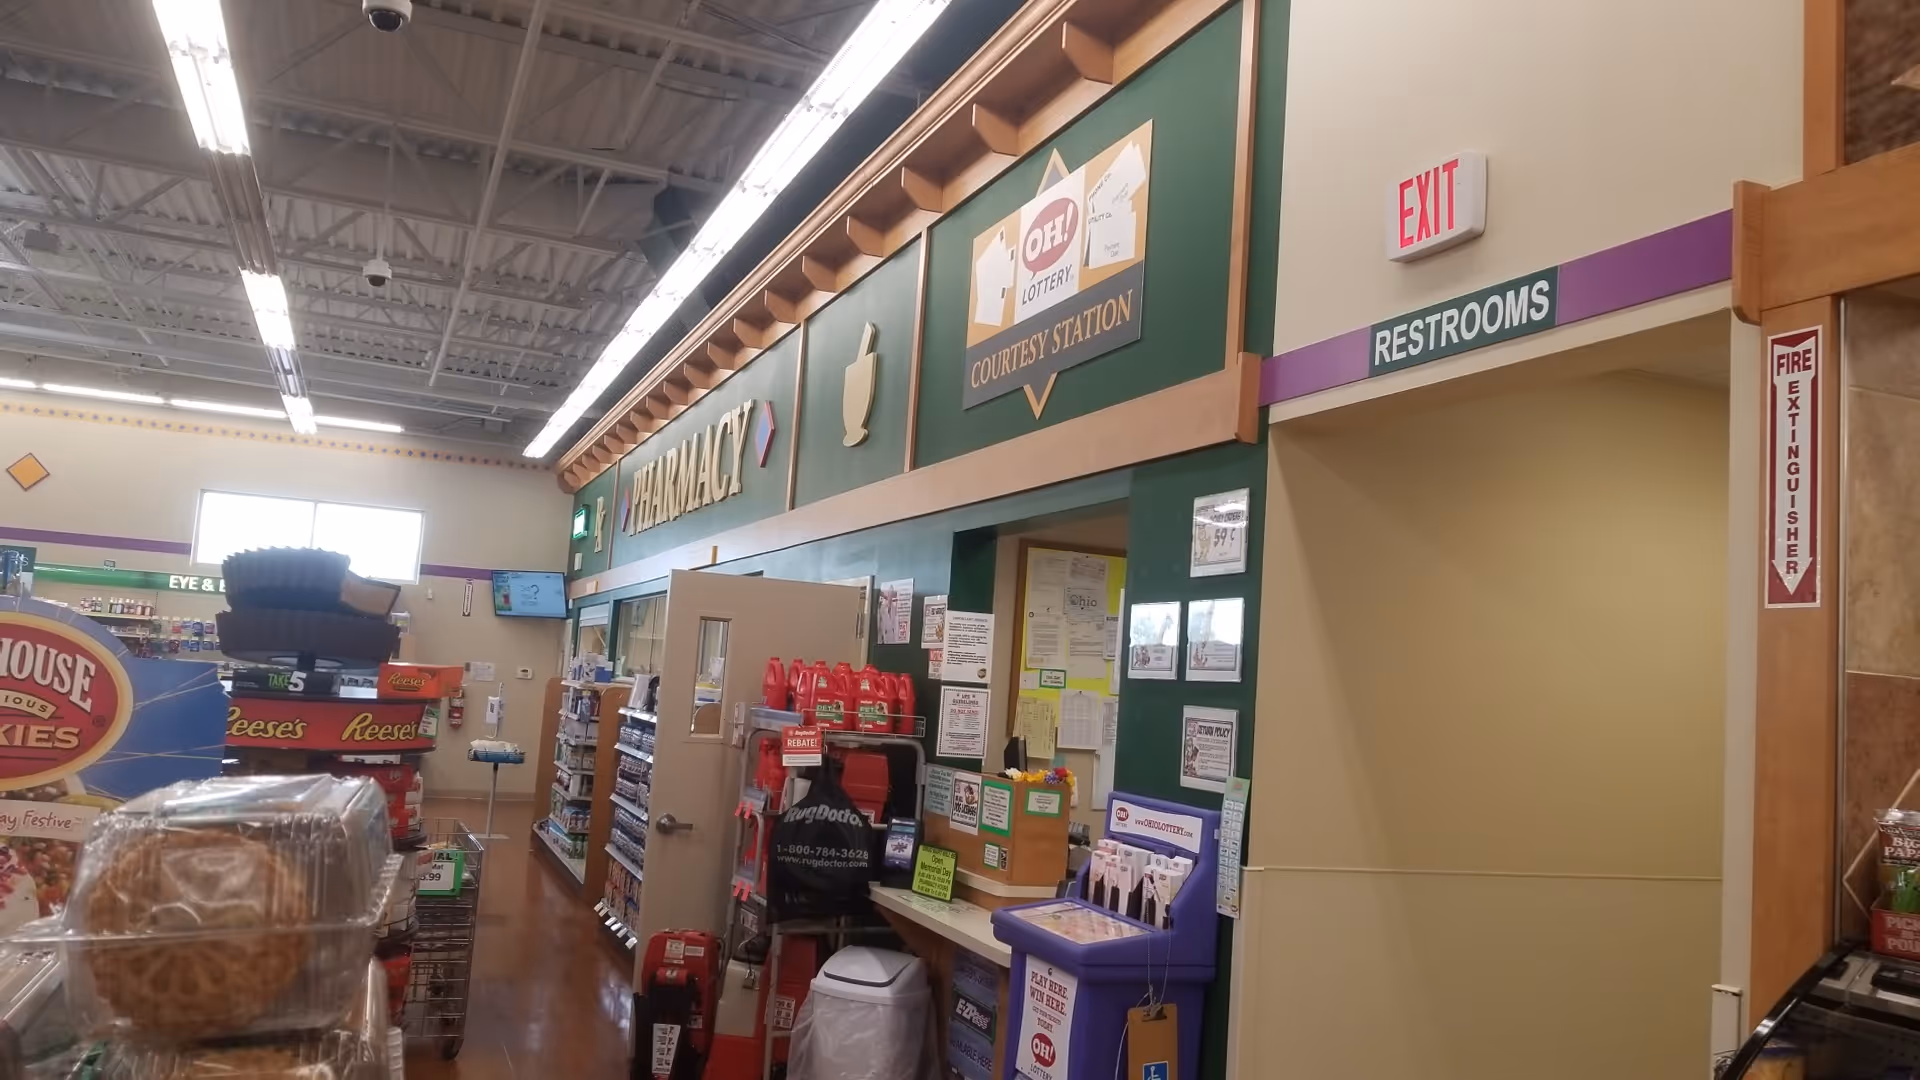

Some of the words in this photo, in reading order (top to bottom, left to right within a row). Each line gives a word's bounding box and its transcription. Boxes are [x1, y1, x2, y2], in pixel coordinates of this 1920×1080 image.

[1399, 158, 1459, 248] EXIT
[1025, 201, 1074, 262] OH!
[1022, 264, 1072, 305] LOTTERY
[1374, 279, 1550, 366] RESTROOMS
[971, 329, 1049, 388] COURTESY
[1051, 289, 1133, 354] STATION
[1776, 348, 1812, 376] FIRE
[628, 398, 754, 537] PHARMACY
[1786, 380, 1800, 574] EXTINGUISHER
[1214, 528, 1227, 547] 59
[169, 575, 198, 590] EYE
[201, 577, 215, 592] &
[268, 672, 289, 689] TAKE
[287, 671, 307, 692] 5
[388, 671, 426, 688] Reese's
[0, 723, 80, 749] KIES
[341, 712, 417, 742] Reese's
[787, 738, 817, 747] REBATE!
[23, 809, 72, 829] Festive
[777, 844, 869, 860] 1-800-784-3628
[777, 855, 868, 868] www.rugdoctor.com
[1030, 971, 1048, 989] PLAY
[1048, 979, 1069, 1000] HERE.
[1029, 986, 1045, 1005] WIN
[1045, 993, 1067, 1016] HERE.
[1032, 1038, 1054, 1062] OH!
[1030, 1063, 1053, 1080] LOTTERY
